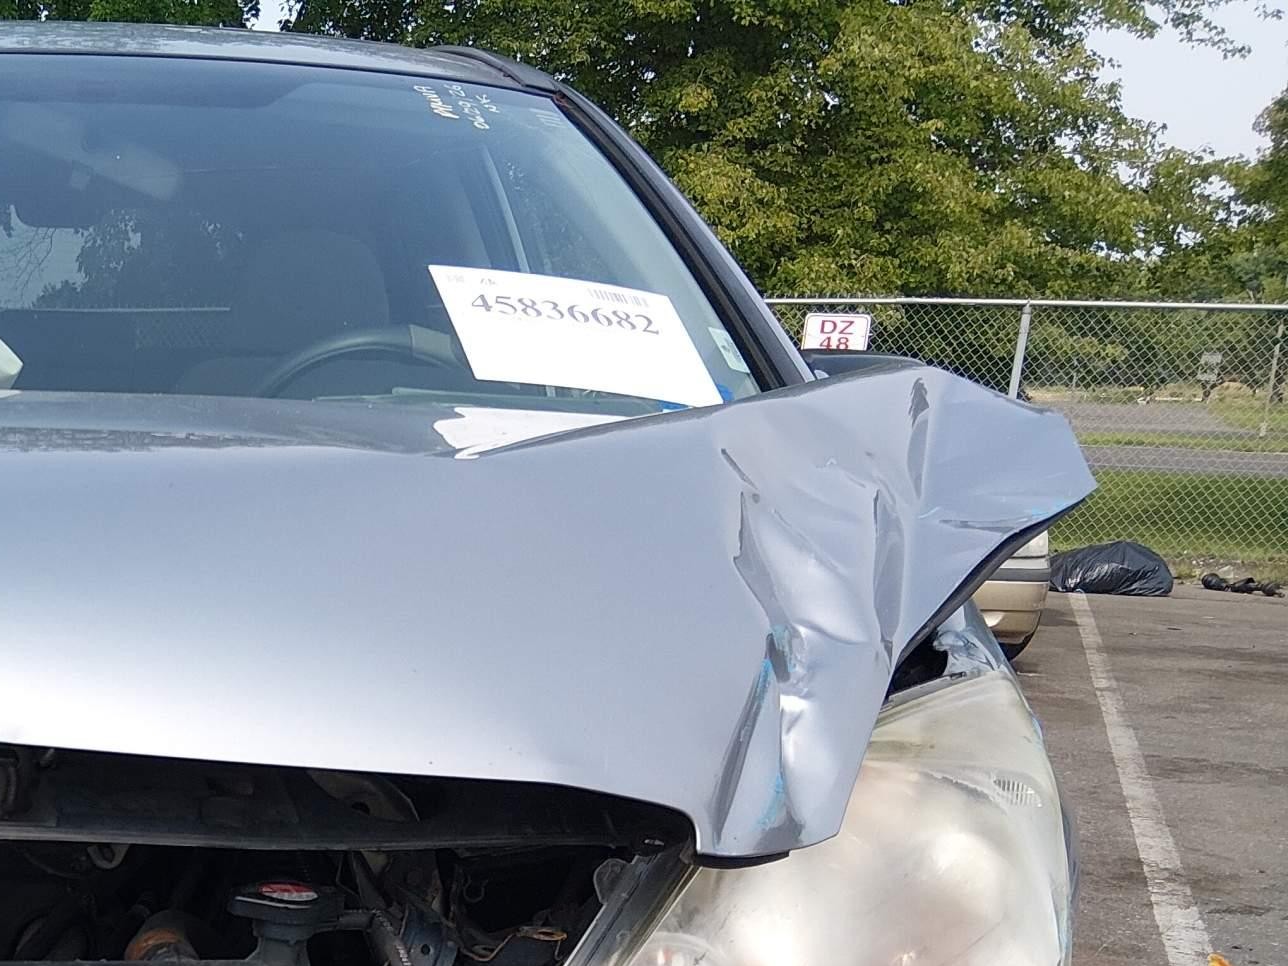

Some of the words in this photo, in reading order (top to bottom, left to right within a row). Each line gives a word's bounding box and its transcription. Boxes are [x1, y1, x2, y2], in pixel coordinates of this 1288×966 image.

[471, 294, 660, 335] 45836682
[819, 319, 855, 335] DZ
[819, 336, 849, 351] 48
